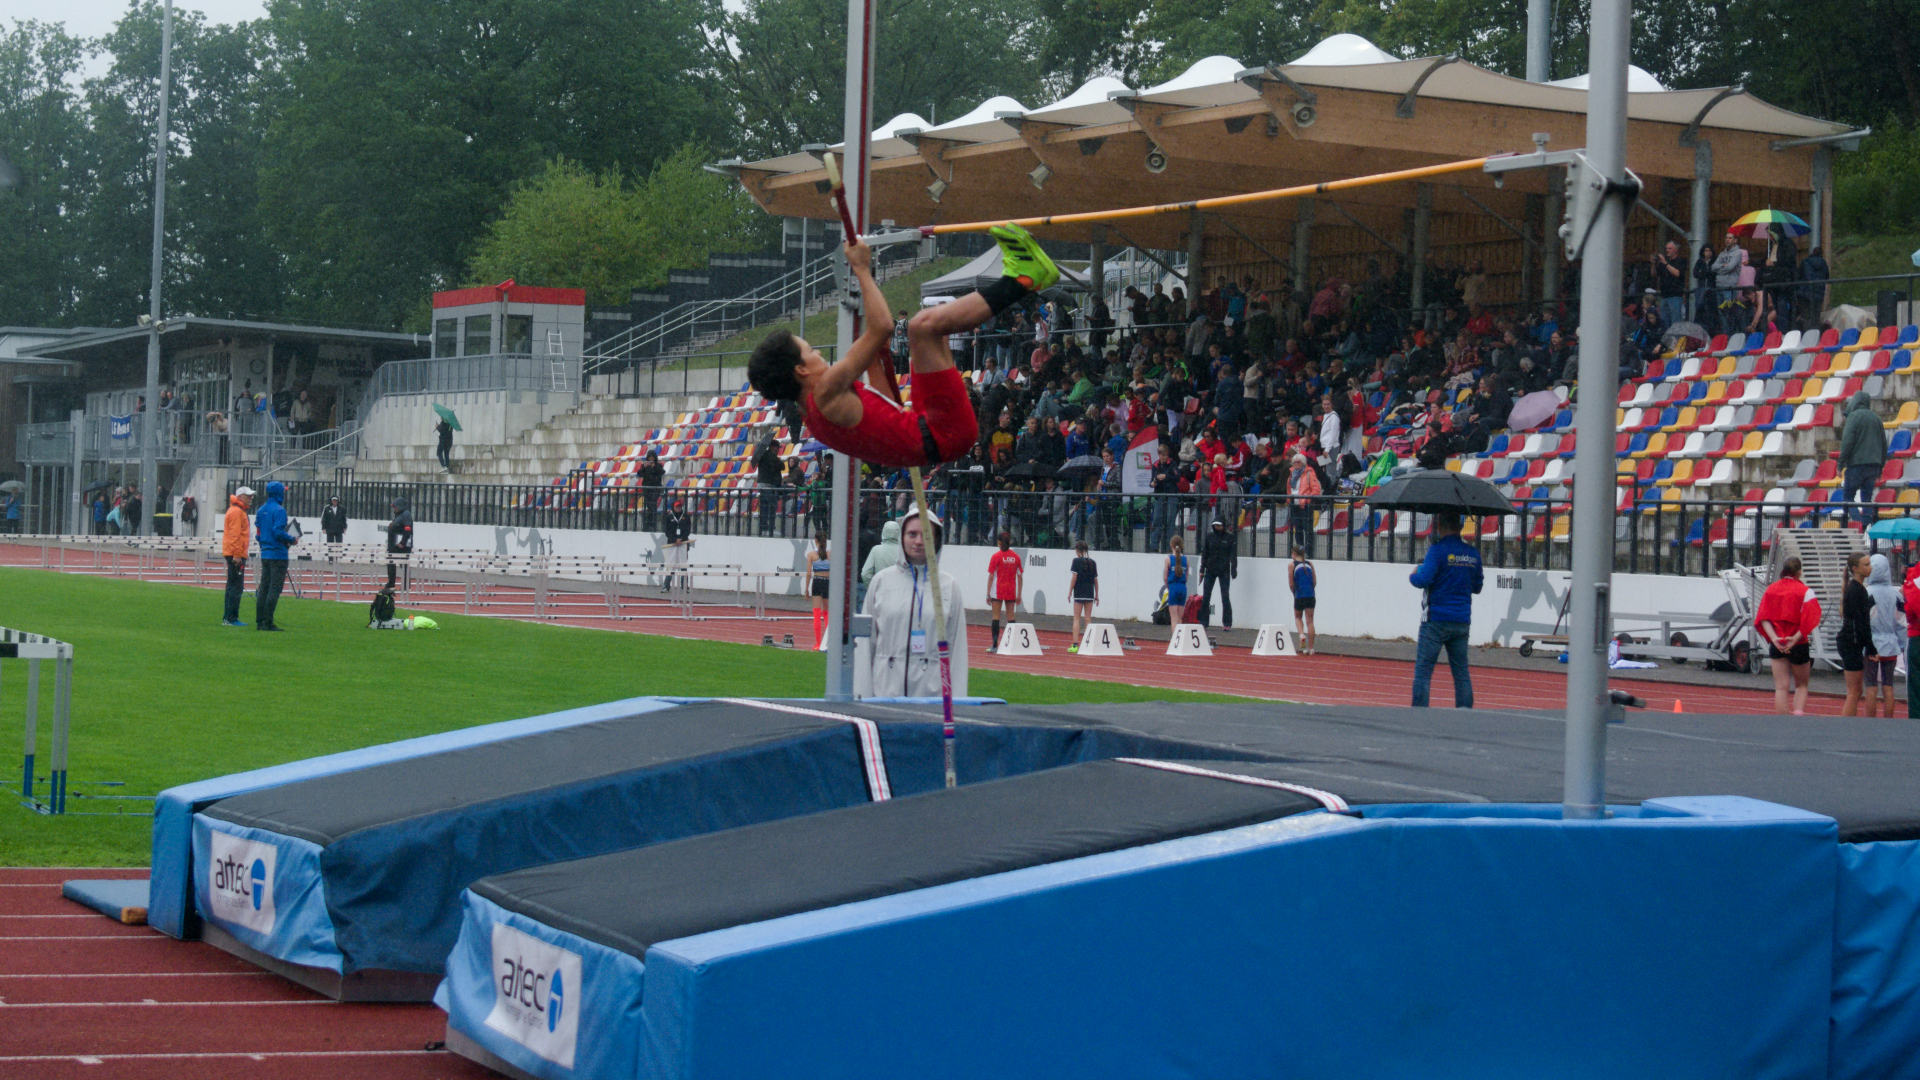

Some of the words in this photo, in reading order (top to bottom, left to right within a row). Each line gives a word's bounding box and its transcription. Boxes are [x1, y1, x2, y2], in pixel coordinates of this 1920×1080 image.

[1496, 574, 1522, 589] Hürden
[1020, 628, 1030, 649] 3
[1101, 628, 1111, 649] 4
[1191, 629, 1201, 649] 5
[1275, 631, 1285, 651] 6
[215, 854, 250, 896] artec
[502, 955, 545, 1013] artec
